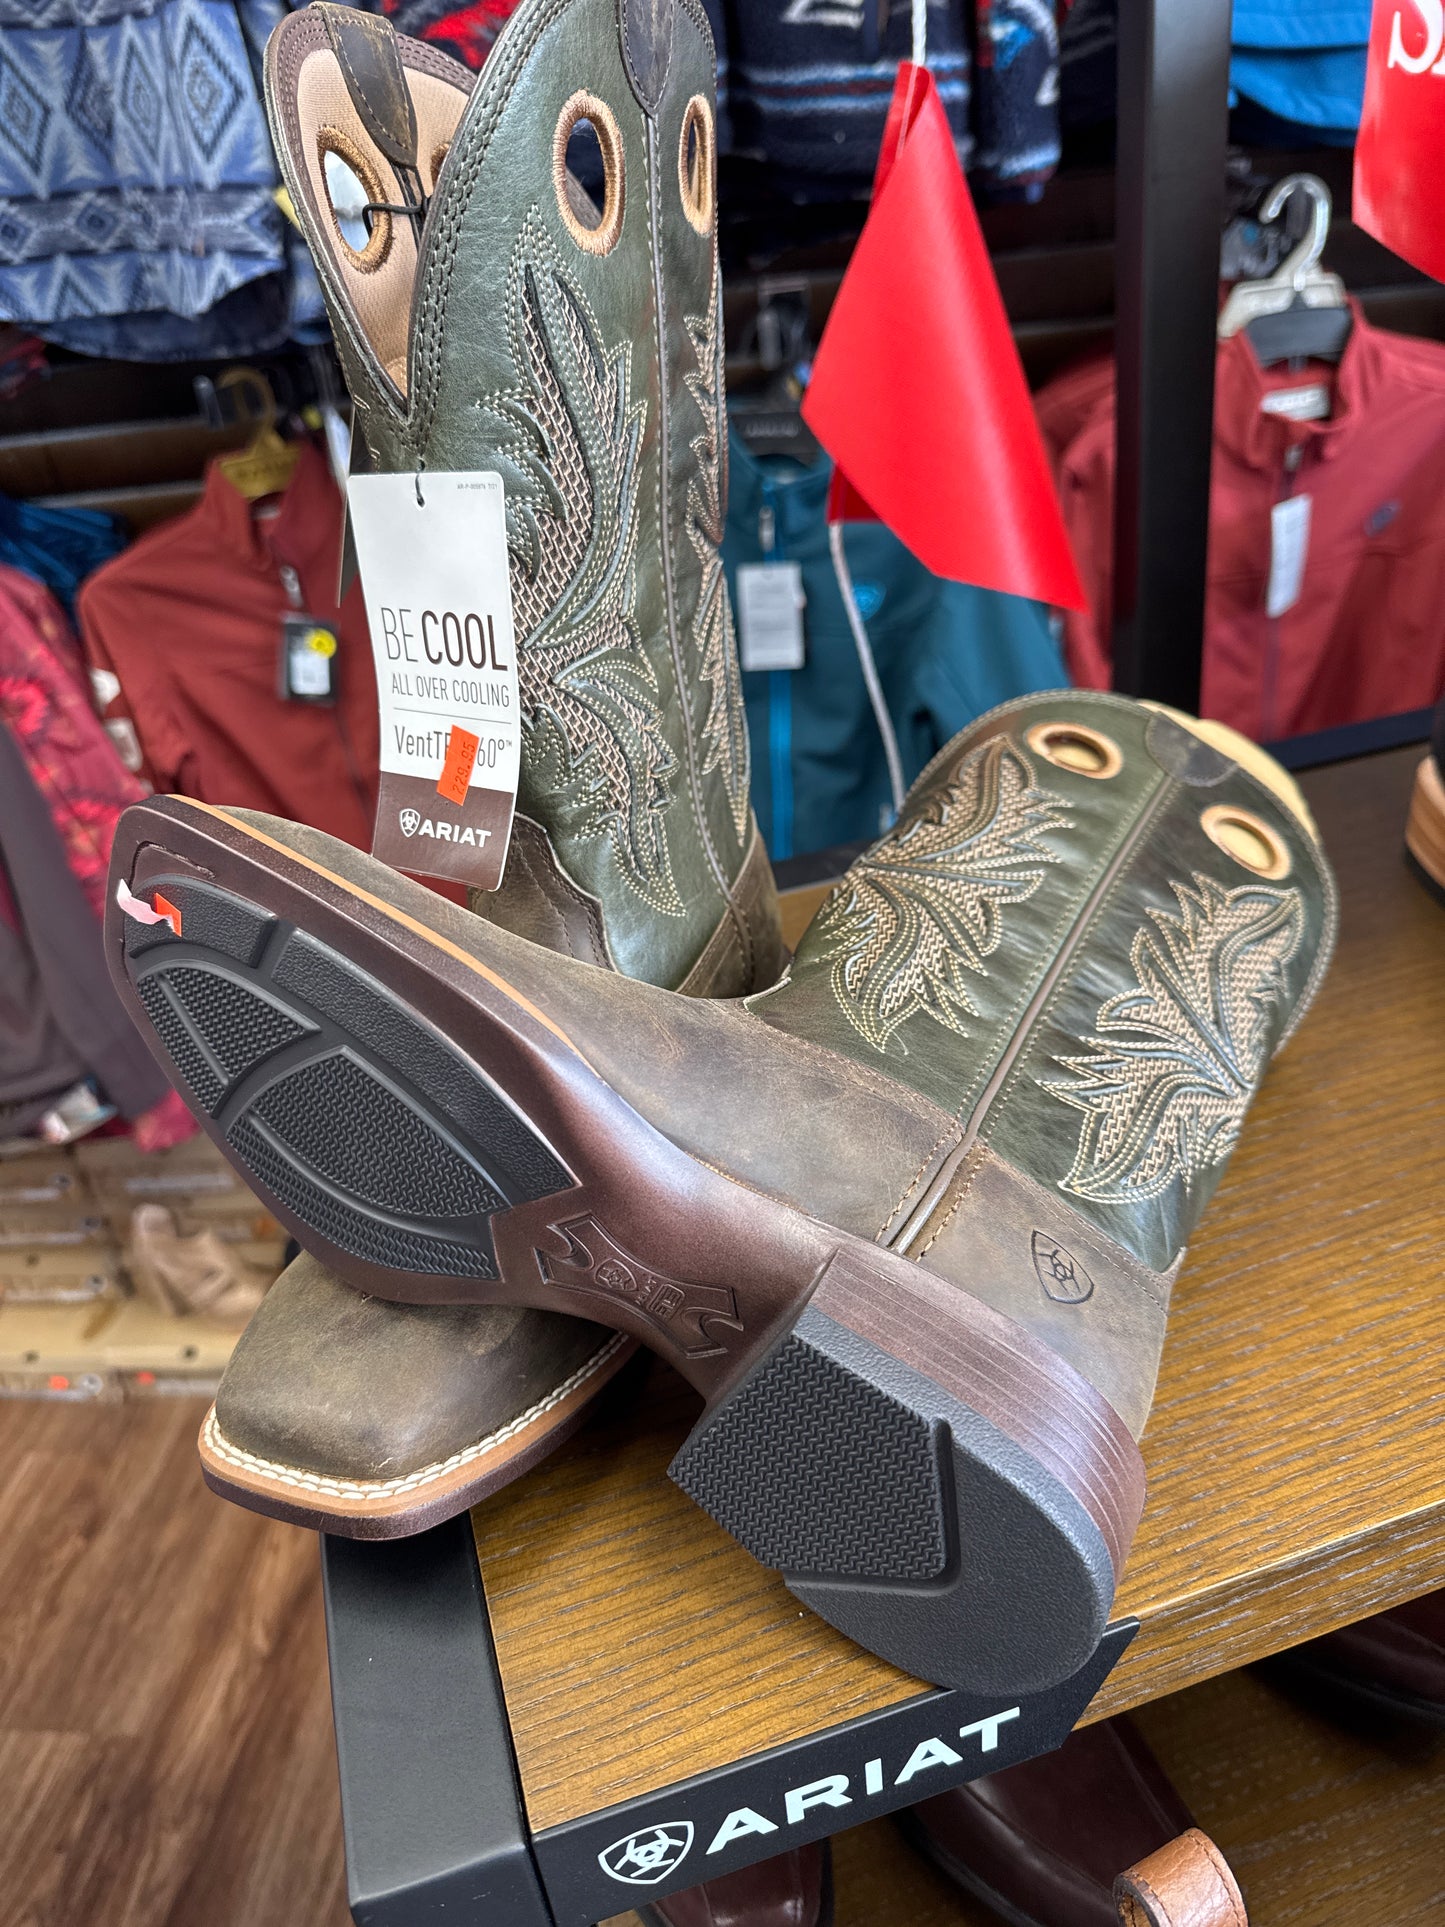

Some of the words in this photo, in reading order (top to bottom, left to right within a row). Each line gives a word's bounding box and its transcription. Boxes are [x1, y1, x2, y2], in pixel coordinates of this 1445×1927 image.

[1387, 0, 1445, 75] S
[381, 607, 418, 662] BE
[421, 610, 508, 671] COOL
[392, 673, 413, 696] ALL
[416, 676, 449, 701] OVER
[452, 680, 510, 708] COOLING
[394, 725, 452, 761] VentT
[452, 741, 476, 796] 229.95
[419, 818, 492, 848] ARIAT
[705, 1706, 1020, 1855] ARIAT
